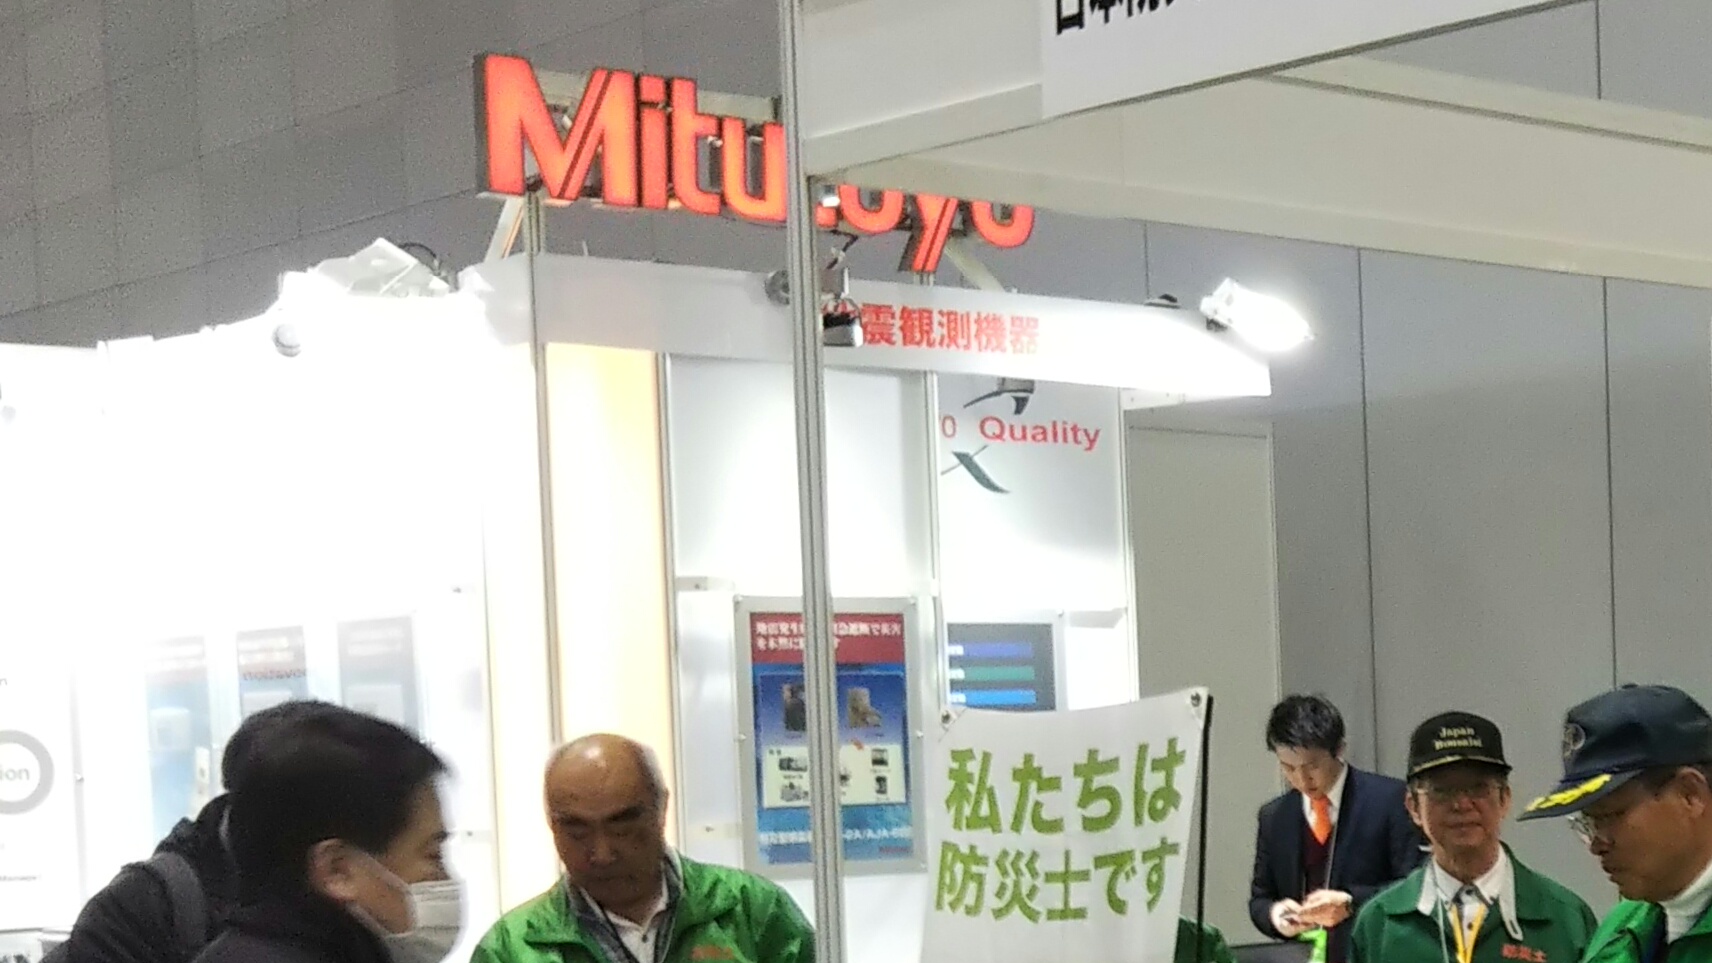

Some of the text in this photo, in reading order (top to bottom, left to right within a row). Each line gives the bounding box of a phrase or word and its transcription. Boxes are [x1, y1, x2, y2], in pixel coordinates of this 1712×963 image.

[822, 301, 1040, 354] 震観測機器
[979, 415, 1101, 452] Quality
[945, 738, 1186, 835] 私たちは
[934, 837, 1181, 924] 防災士です
